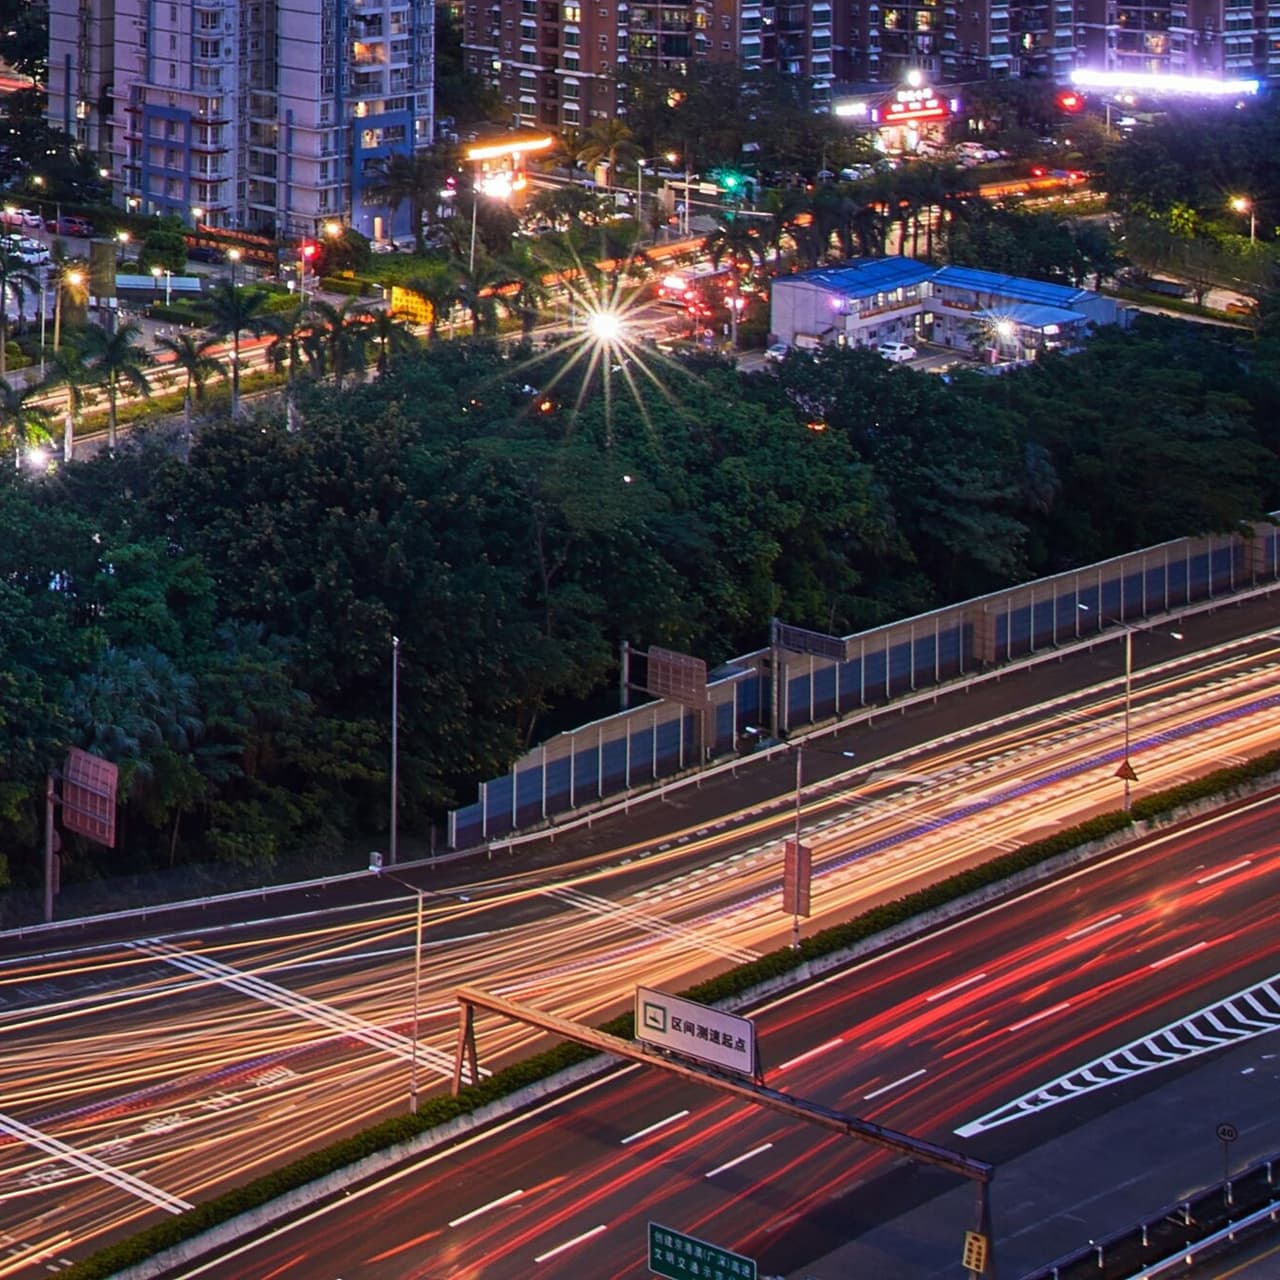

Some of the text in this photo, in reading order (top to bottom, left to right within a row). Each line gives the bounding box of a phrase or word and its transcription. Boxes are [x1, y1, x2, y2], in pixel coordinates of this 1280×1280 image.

[671, 1015, 746, 1053] 区间测速起点
